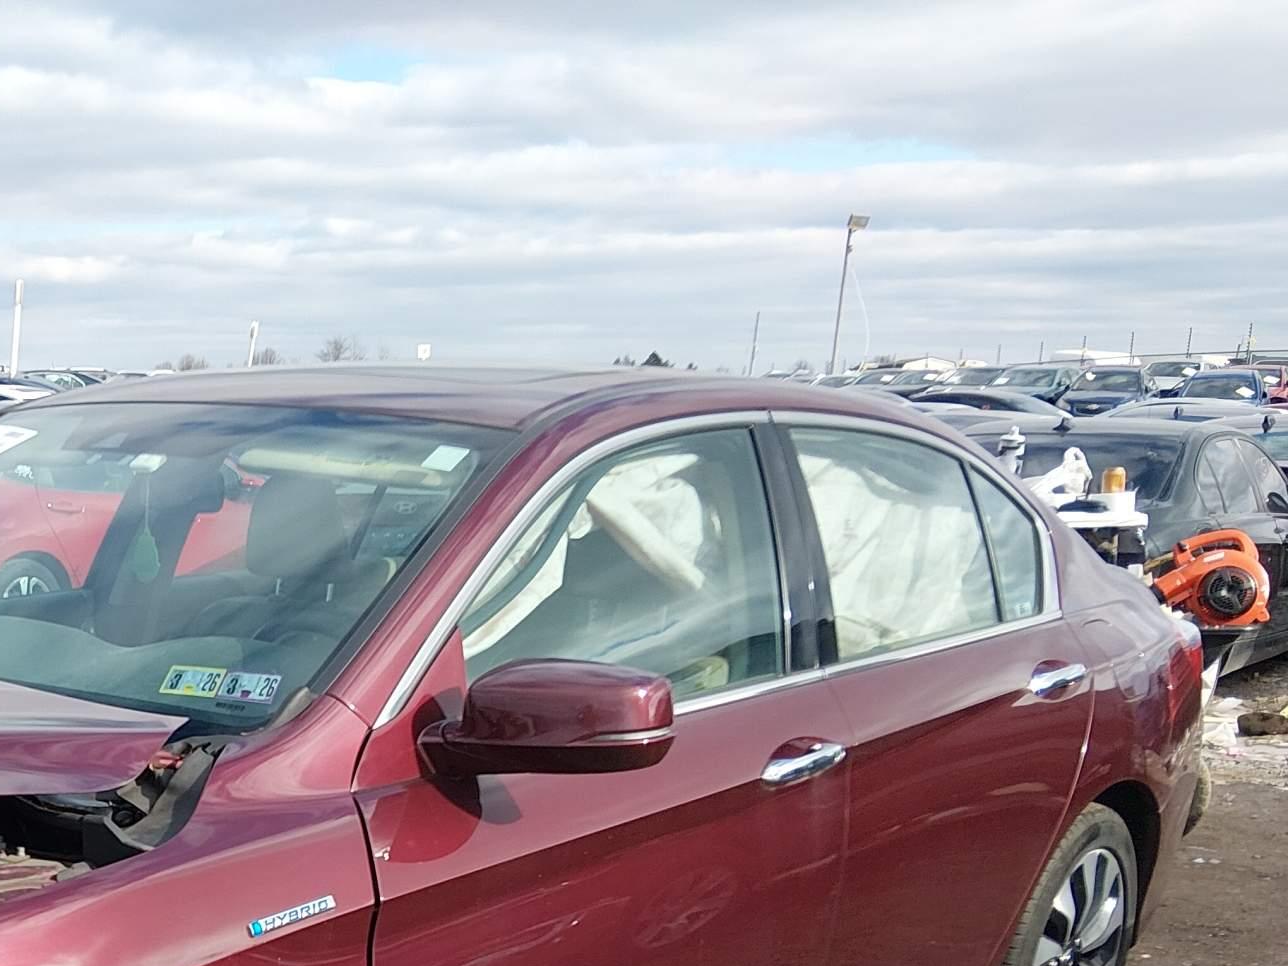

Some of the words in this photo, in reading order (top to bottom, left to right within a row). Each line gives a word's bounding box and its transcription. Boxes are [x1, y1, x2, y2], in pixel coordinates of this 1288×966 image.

[201, 672, 223, 692] 26
[258, 677, 279, 698] 26
[263, 899, 329, 932] HYBRID
